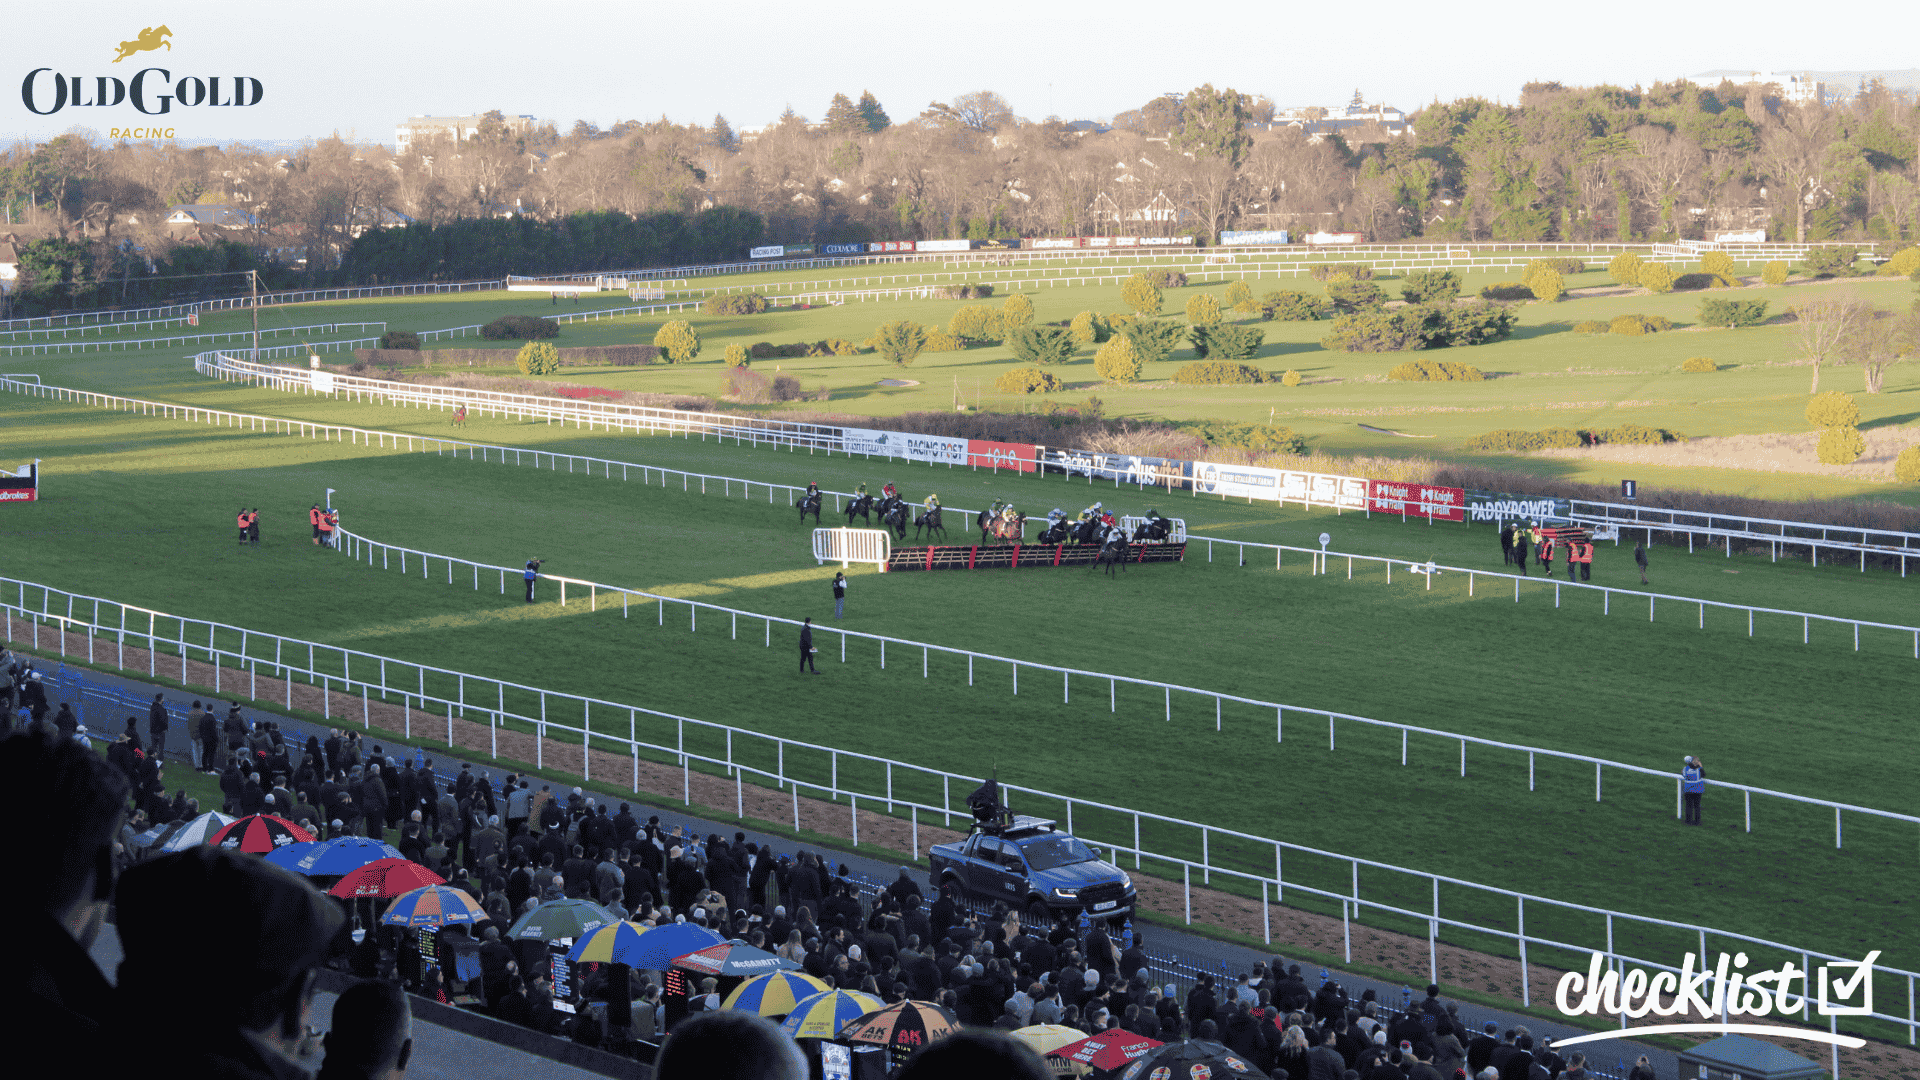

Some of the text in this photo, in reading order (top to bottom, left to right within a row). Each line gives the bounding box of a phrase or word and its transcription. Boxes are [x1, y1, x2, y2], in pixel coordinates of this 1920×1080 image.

[1032, 238, 1074, 248] Ladbrokes
[1140, 237, 1170, 245] RACING
[1171, 236, 1192, 245] POST
[752, 248, 769, 257] RACING
[769, 247, 782, 256] POST
[907, 439, 939, 457] RACING
[940, 443, 963, 460] POST
[1057, 451, 1108, 477] Racing TV
[1389, 485, 1409, 500] Knight
[1626, 481, 1632, 497] 1
[1434, 491, 1454, 505] Knight
[730, 957, 781, 969] McGARRITY
[865, 1026, 887, 1035] AK
[1084, 1040, 1106, 1050] AWAY
[1120, 1041, 1149, 1052] Franco
[1081, 1047, 1098, 1056] BET
[1072, 1052, 1093, 1062] HERE
